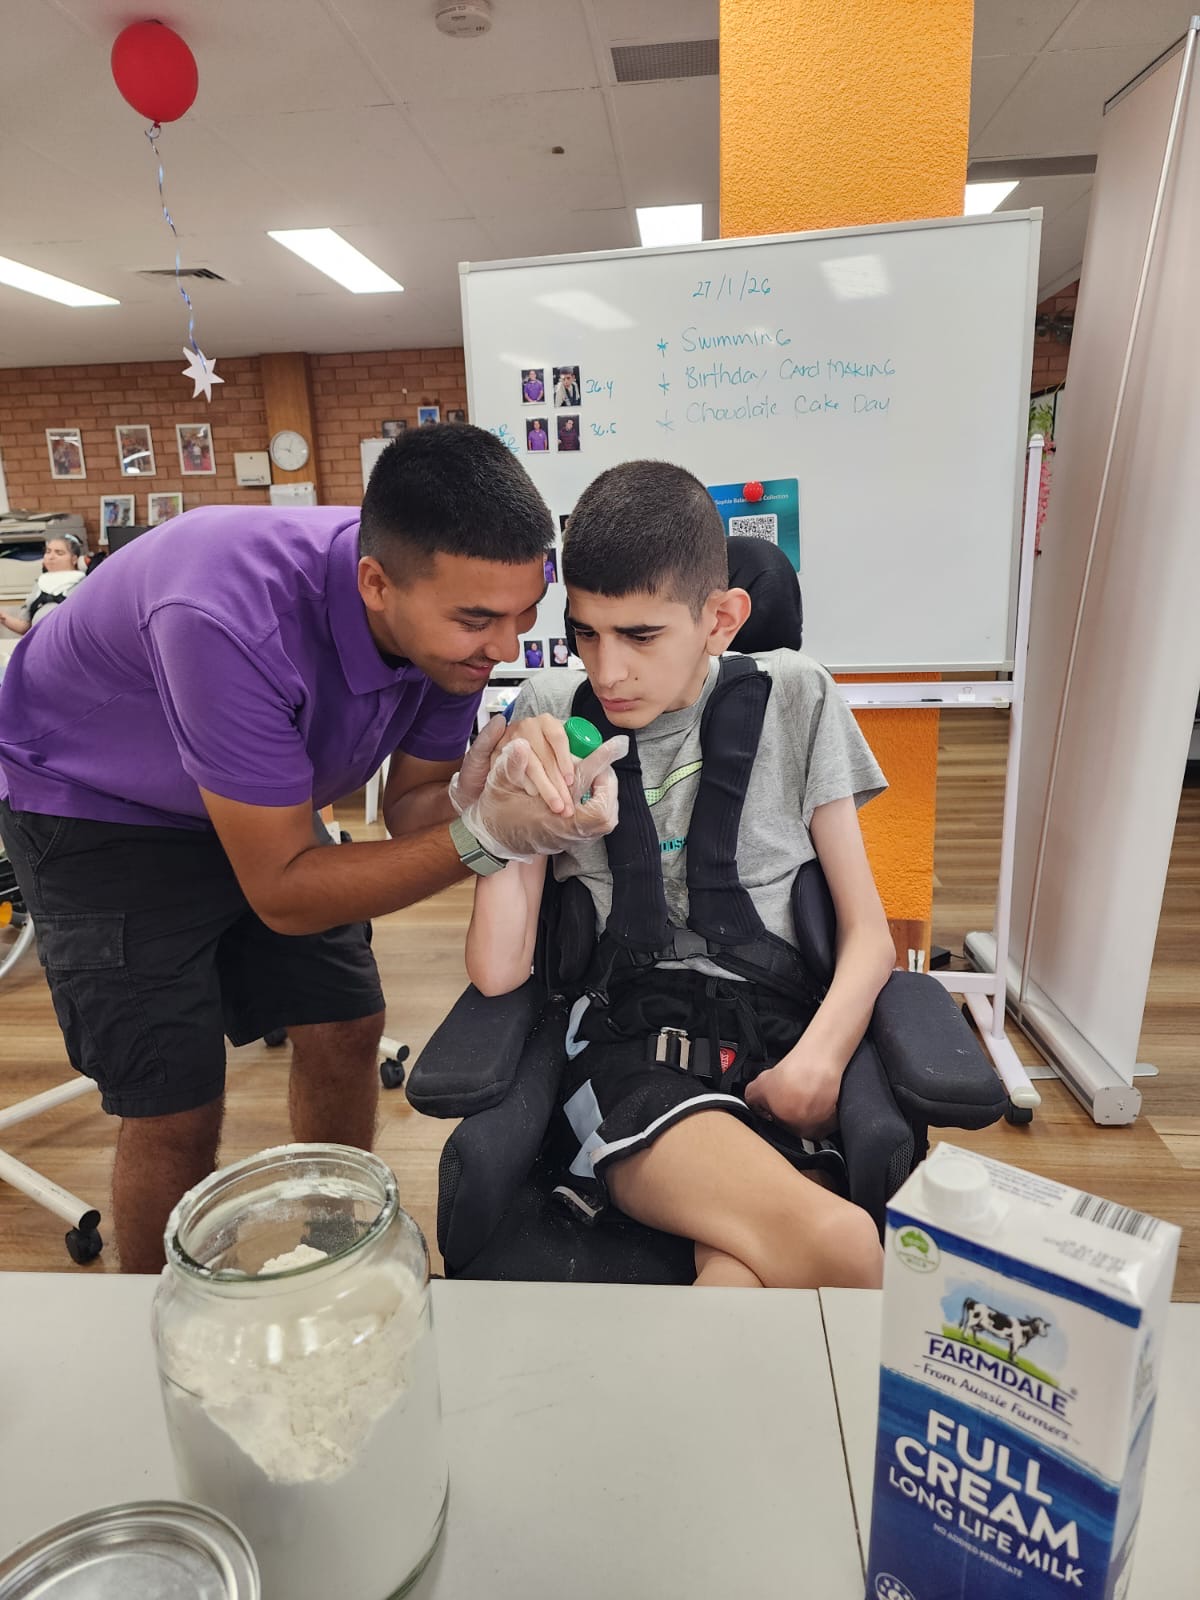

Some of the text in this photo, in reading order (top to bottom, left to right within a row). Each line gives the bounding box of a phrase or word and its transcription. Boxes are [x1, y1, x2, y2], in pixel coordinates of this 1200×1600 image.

[693, 270, 771, 301] 27/1/26
[795, 394, 839, 416] Cake
[923, 1363, 1069, 1441] From Aussie Farmers
[929, 1338, 1067, 1417] FARMDALE
[926, 1409, 1053, 1505] FULL
[889, 1465, 1086, 1588] LONG LIFE MILK
[895, 1436, 1079, 1560] CREAM
